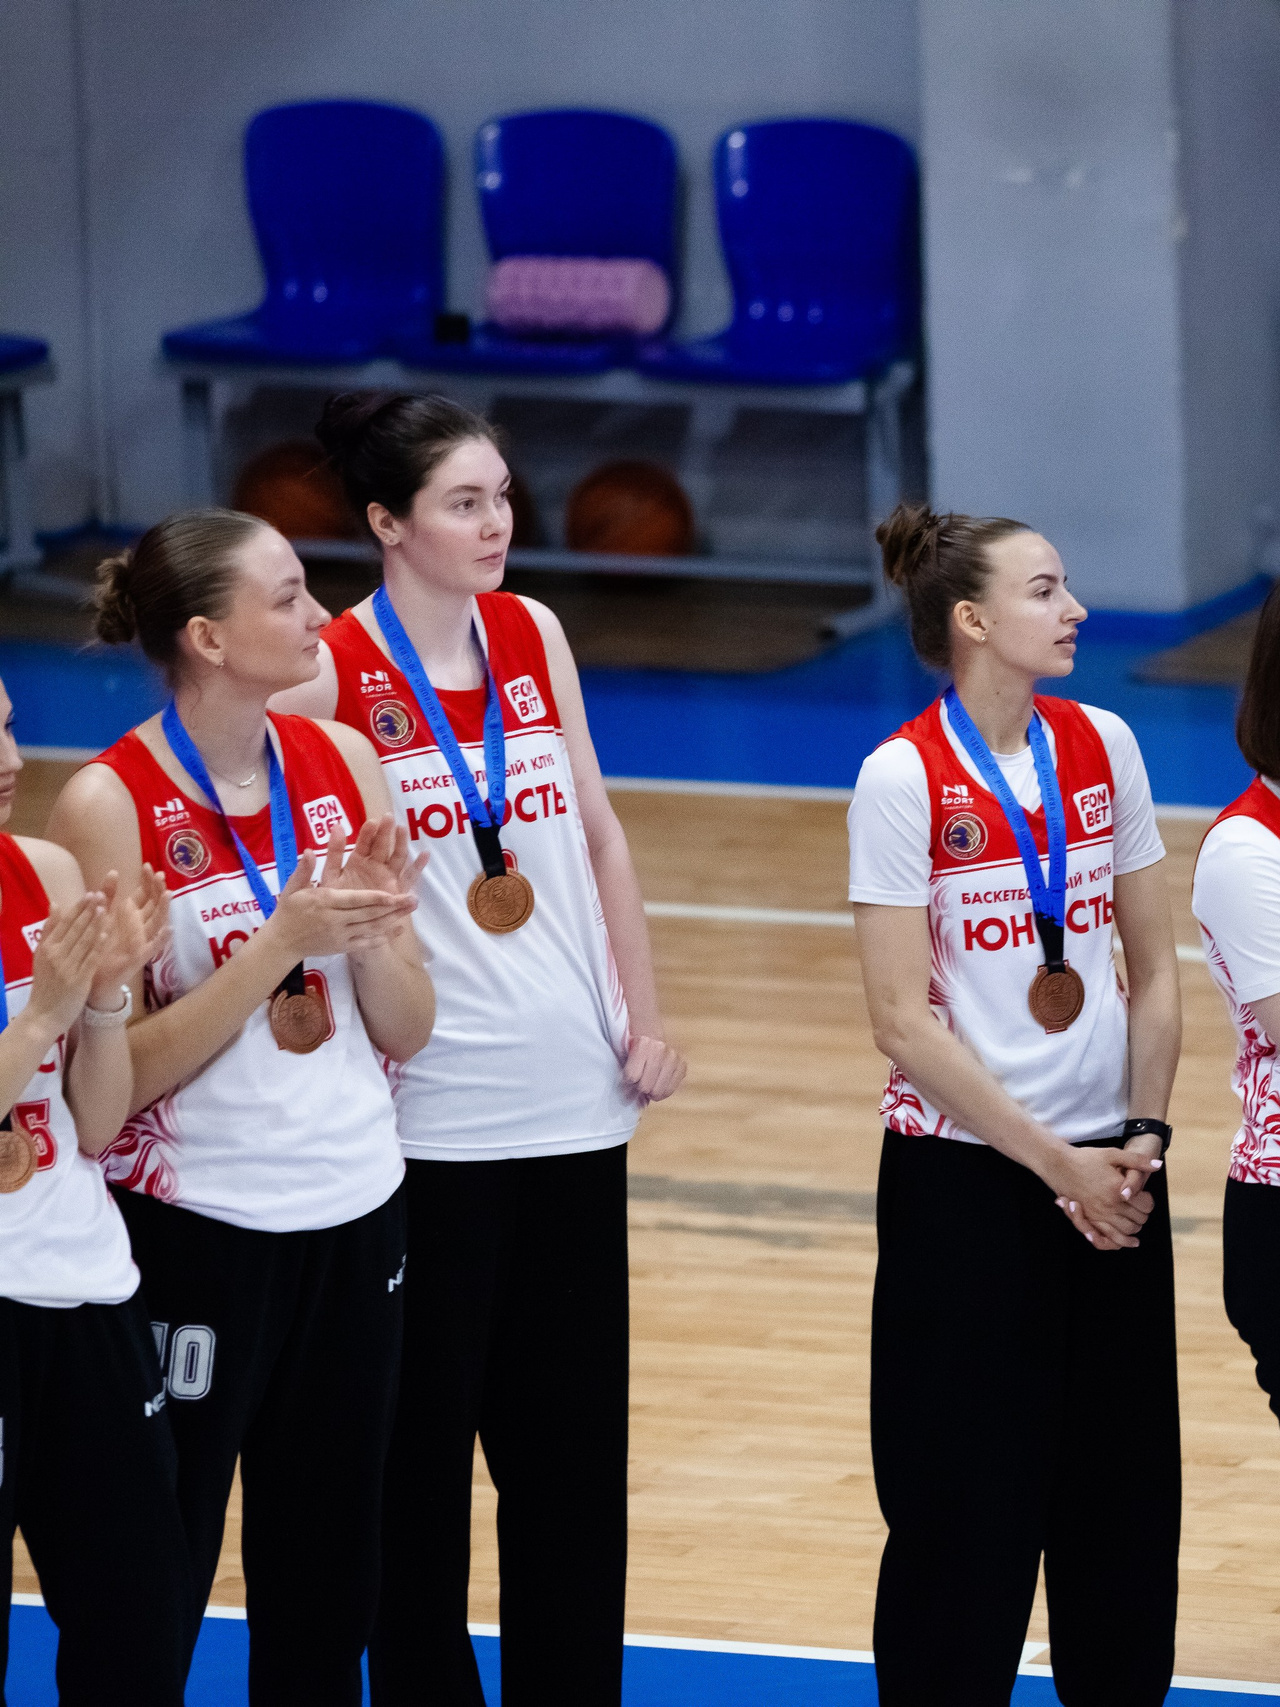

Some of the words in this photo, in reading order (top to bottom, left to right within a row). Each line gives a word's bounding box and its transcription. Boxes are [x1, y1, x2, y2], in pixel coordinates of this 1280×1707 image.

[361, 683, 392, 694] SPOR
[510, 680, 534, 702] FON
[943, 784, 968, 796] N1
[1080, 789, 1107, 810] FON
[154, 798, 184, 817] N1
[308, 800, 338, 822] FON
[1085, 805, 1110, 828] BET
[962, 872, 1082, 904] БАСКЕТБОЫЙ
[1089, 862, 1112, 882] КЛУБ
[964, 892, 1113, 951] ЮНСТЬ
